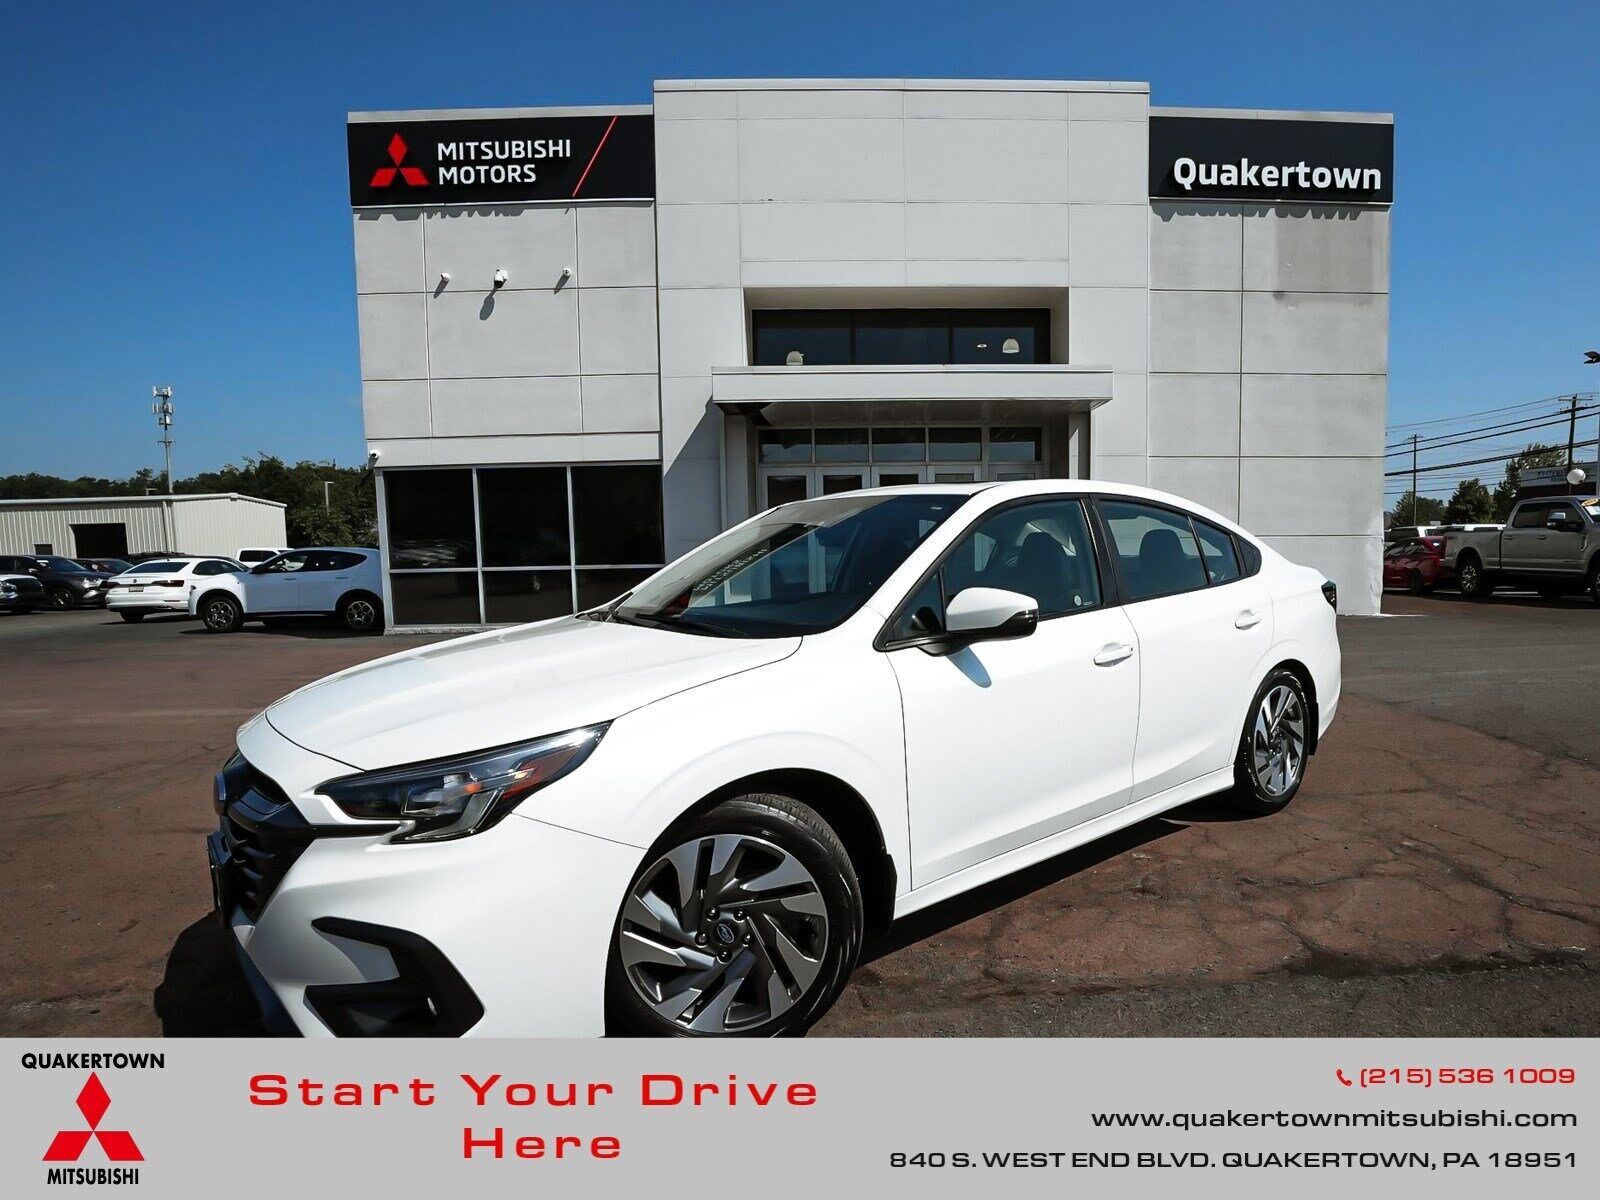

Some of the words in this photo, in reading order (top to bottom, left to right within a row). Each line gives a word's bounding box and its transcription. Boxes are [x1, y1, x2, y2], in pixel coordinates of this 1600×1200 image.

[437, 138, 571, 161] MITSUBISHI
[438, 164, 537, 186] MOTORS
[1173, 156, 1382, 191] Quakertown
